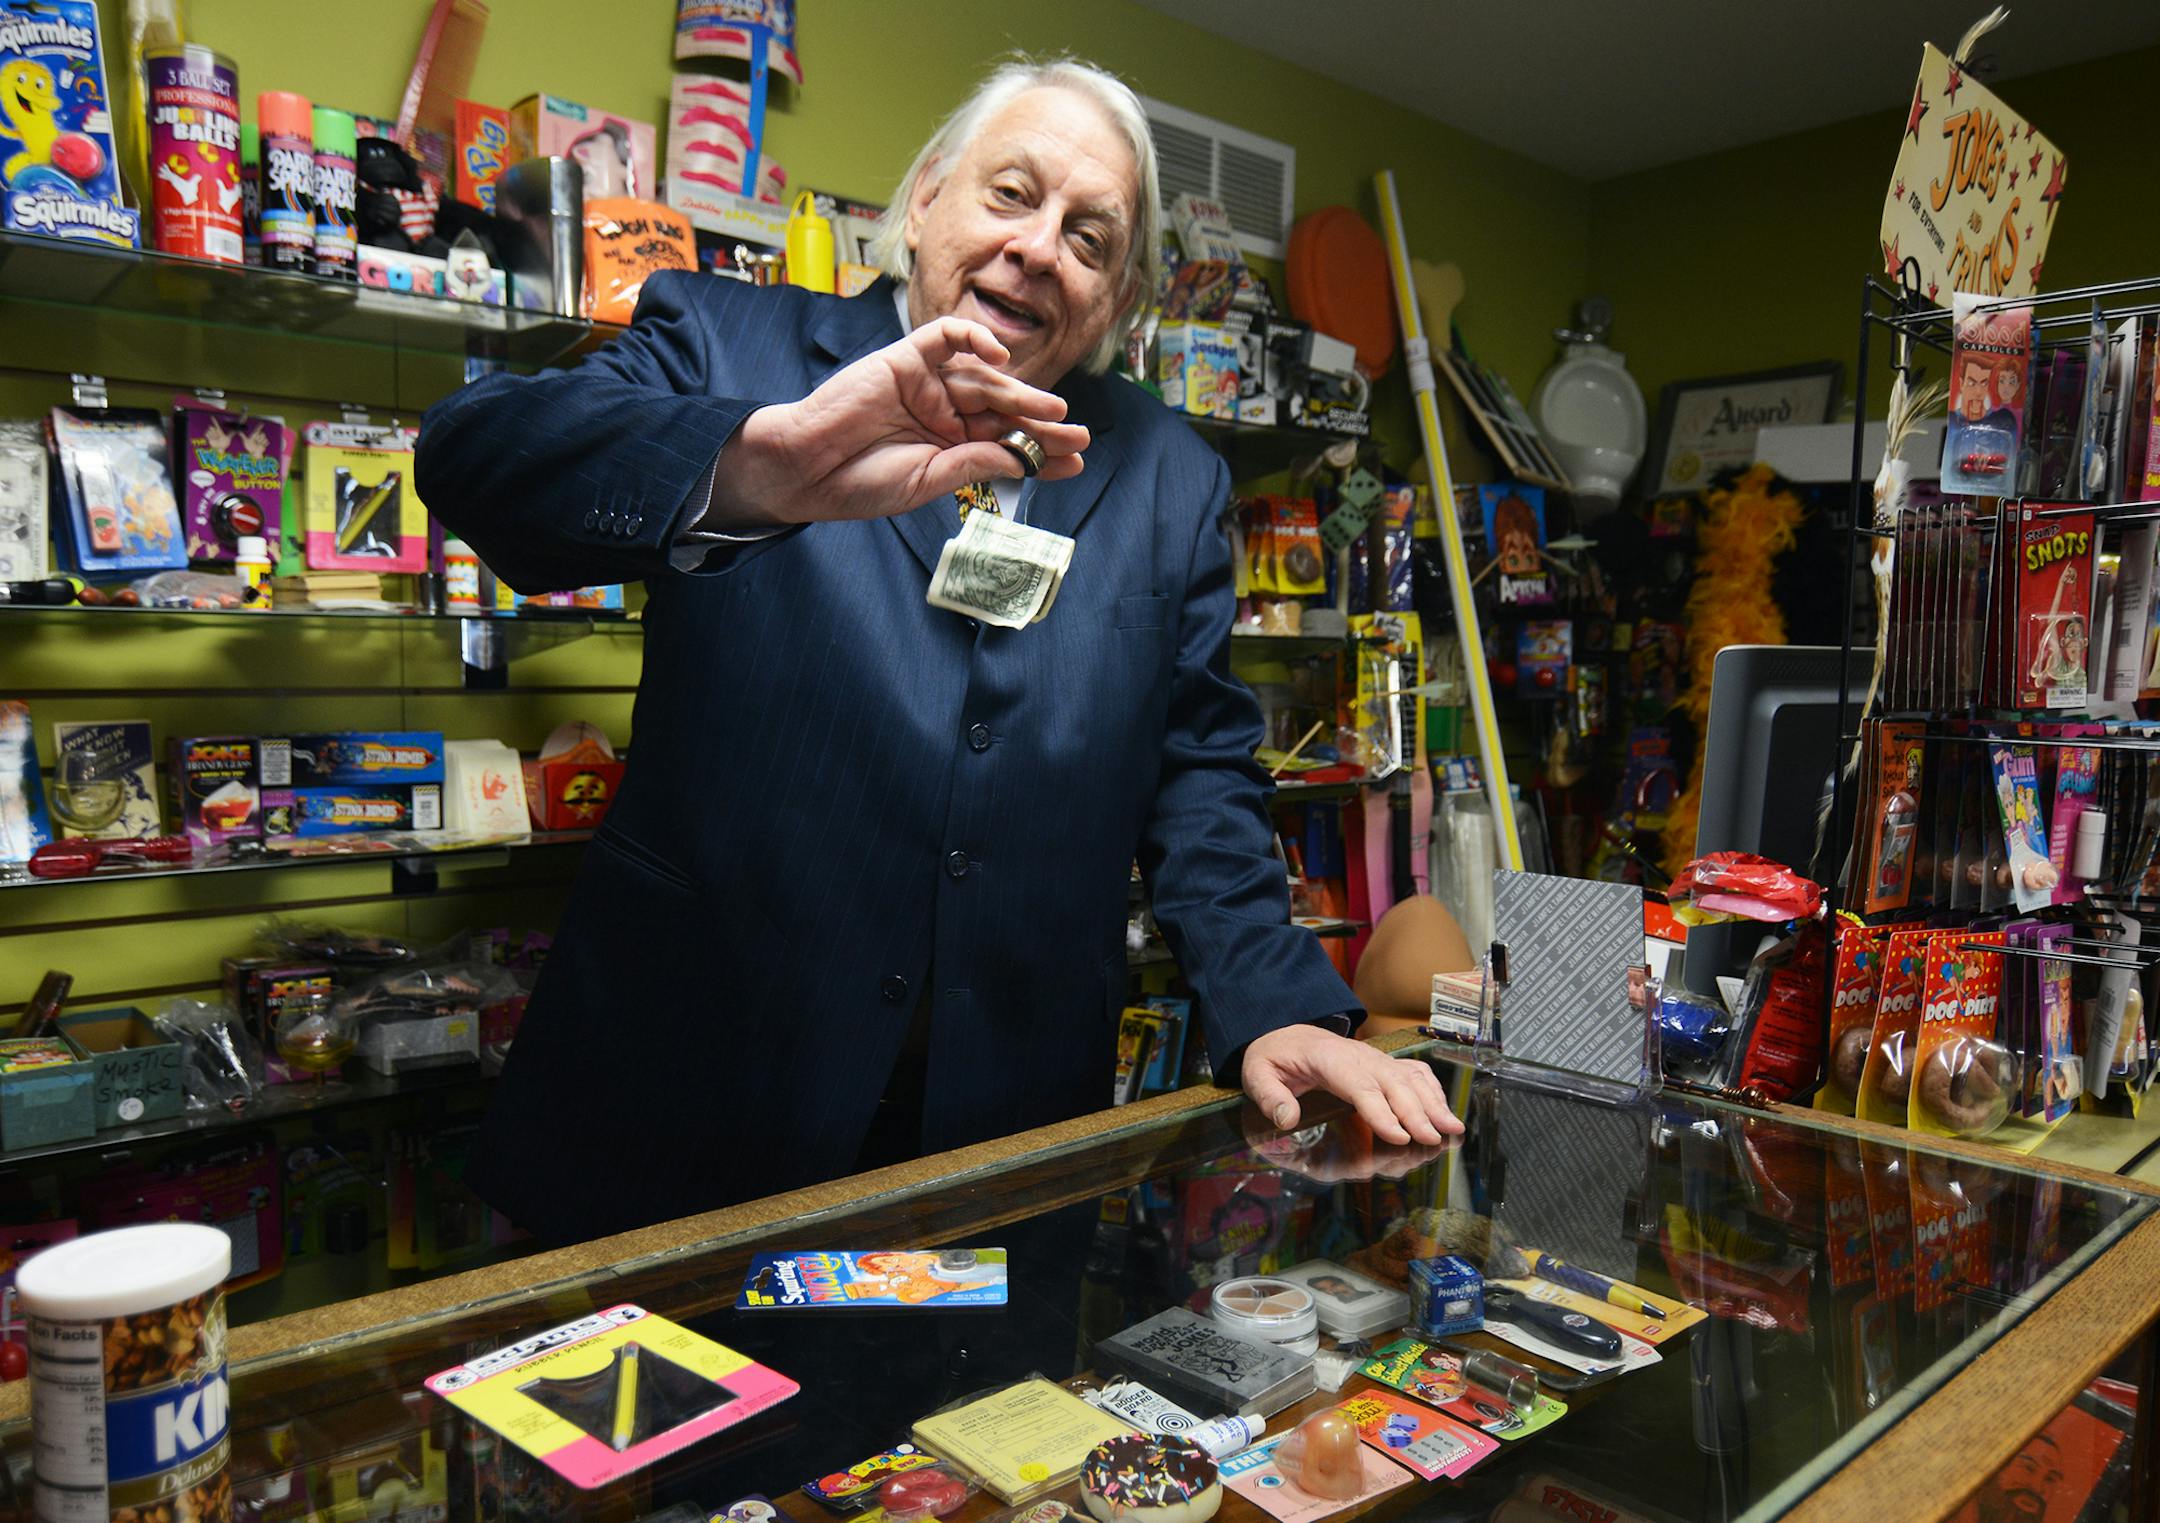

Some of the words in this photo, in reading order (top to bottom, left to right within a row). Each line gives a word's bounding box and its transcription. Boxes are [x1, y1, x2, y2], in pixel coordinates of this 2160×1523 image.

[167, 67, 177, 85] 3
[179, 70, 210, 90] BALL
[211, 76, 232, 98] SET
[172, 123, 236, 151] BALLS
[1930, 106, 2008, 212] JOKES
[13, 195, 135, 237] Squirmles
[1908, 191, 1920, 216] FOR
[1962, 342, 2019, 355] CAPSULES
[1704, 397, 1792, 436] Award
[233, 479, 281, 490] BUTTON
[2025, 531, 2089, 571] SNOTS
[1835, 986, 1872, 1008] DOG
[1881, 992, 1919, 1014] DOG
[1924, 999, 1958, 1023] DOG
[1964, 996, 1998, 1017] DIRT
[772, 1259, 806, 1304] Squirting
[795, 1253, 845, 1303] NICKEL
[1437, 1284, 1480, 1298] PHANTOM
[53, 1328, 98, 1341] Facts
[478, 1318, 599, 1369] adams
[1172, 1327, 1217, 1353] JOKES
[515, 1350, 560, 1374] RUBBER
[563, 1336, 606, 1359] PENCIL
[1114, 1389, 1148, 1410] BOOGER
[1123, 1395, 1154, 1413] BOARD
[1222, 1450, 1270, 1473] THE
[158, 1457, 216, 1496] Deluxe
